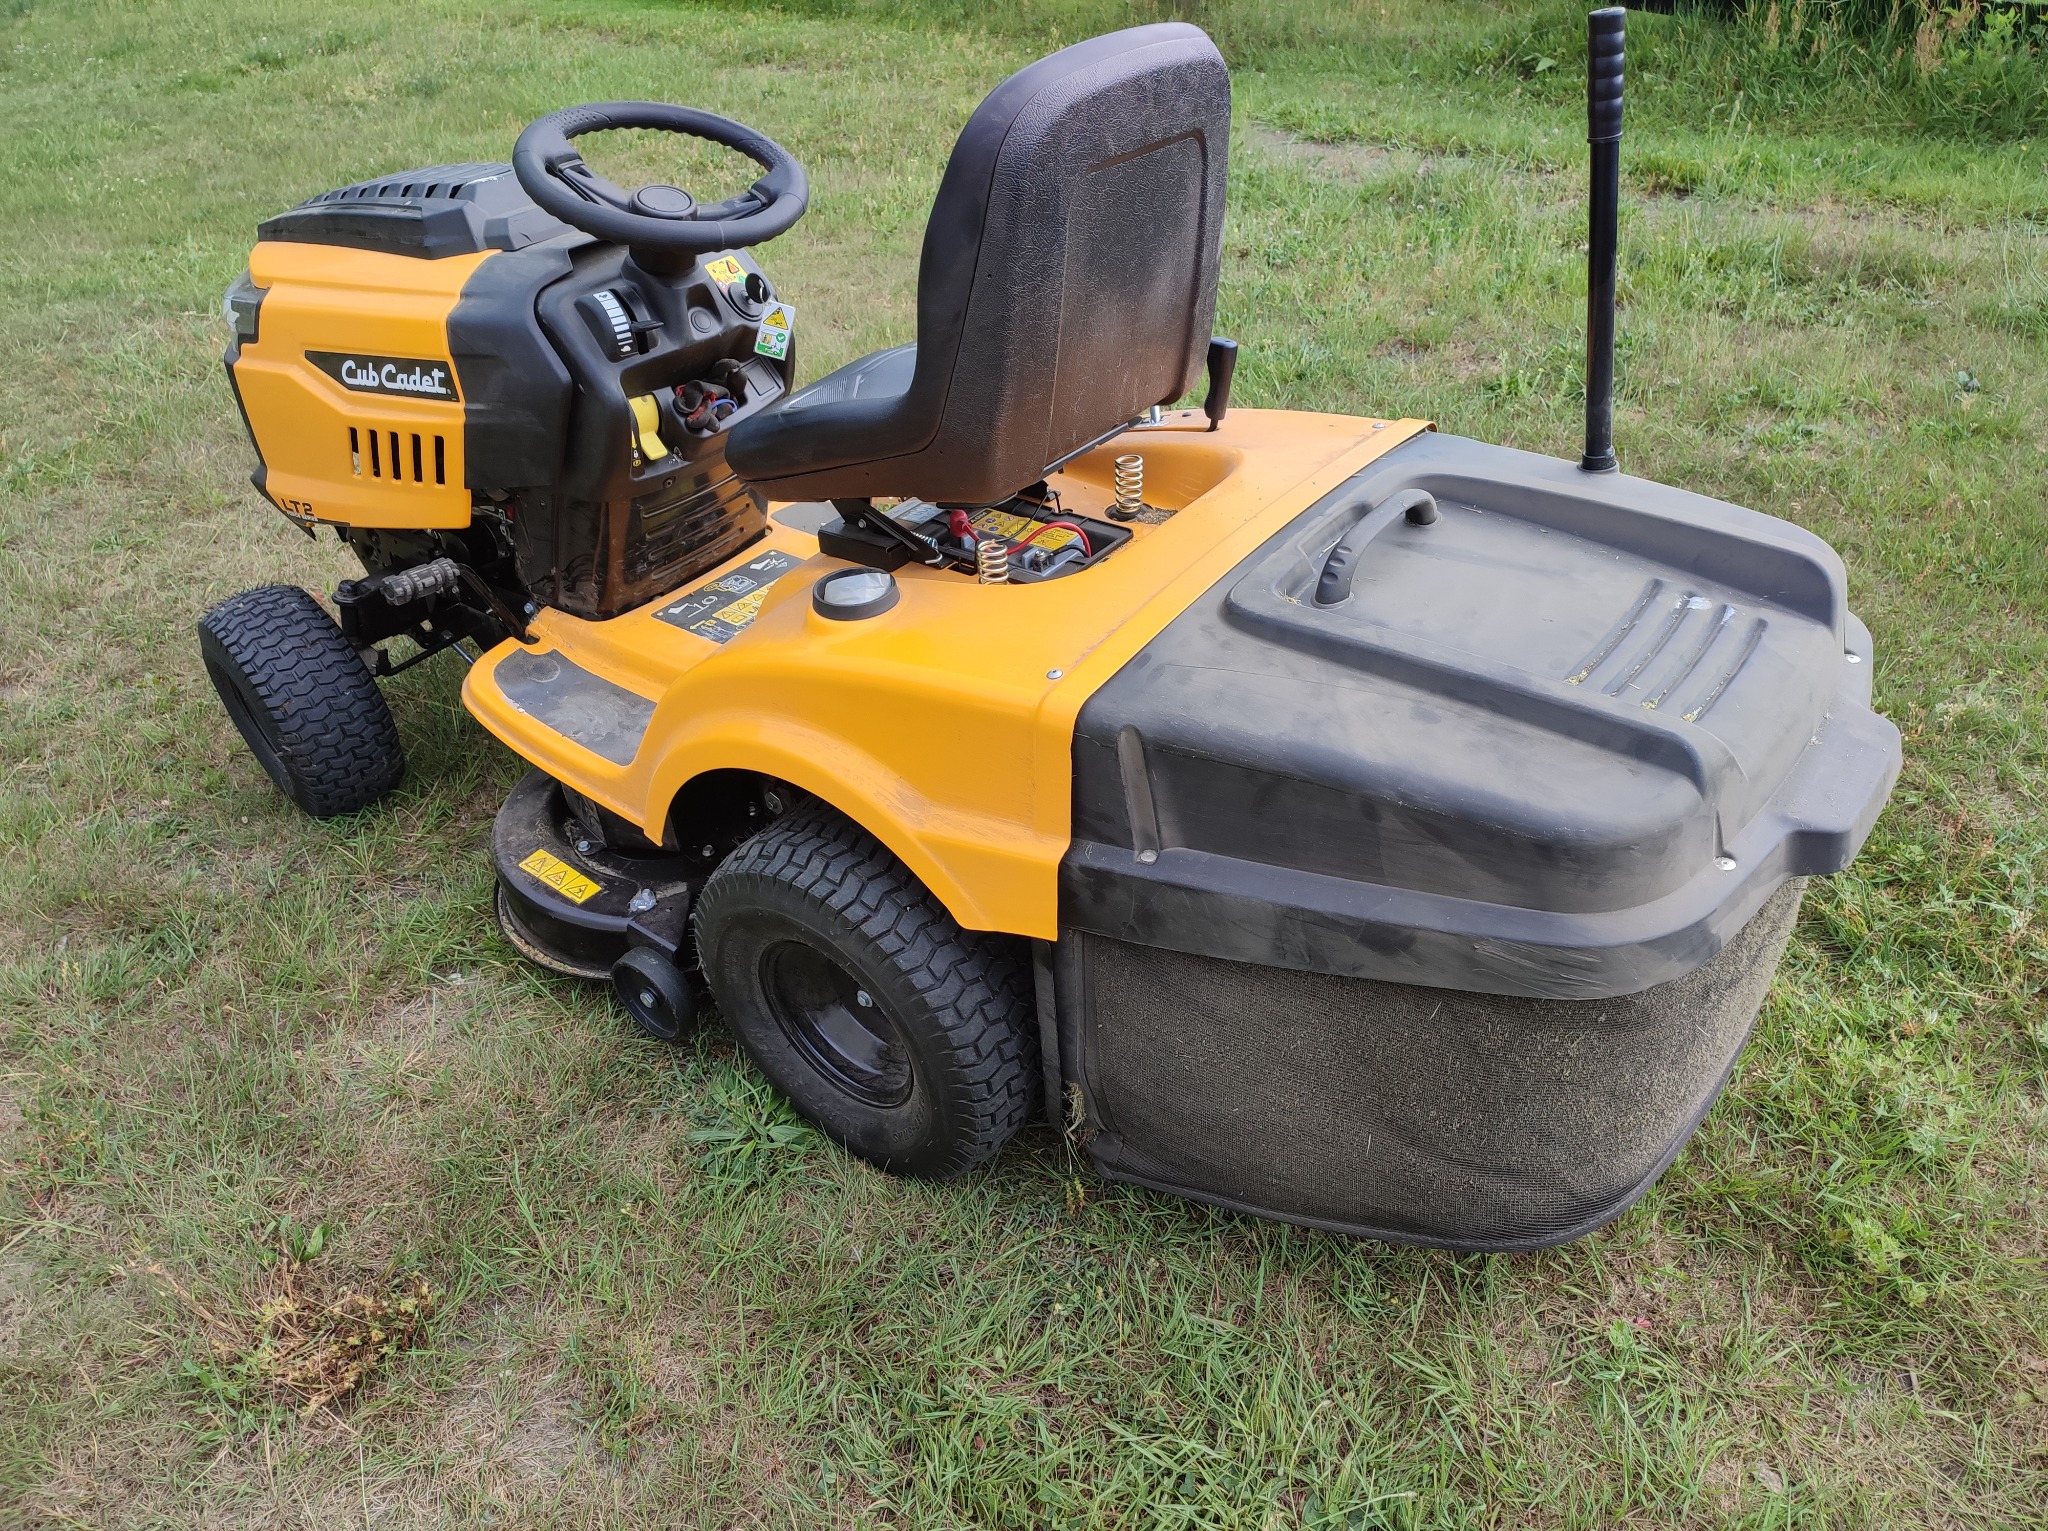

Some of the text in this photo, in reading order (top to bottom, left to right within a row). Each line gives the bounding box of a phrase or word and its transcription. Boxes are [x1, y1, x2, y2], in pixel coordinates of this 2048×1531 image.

[342, 360, 447, 395] Cub Cadet
[280, 497, 315, 516] LT2
